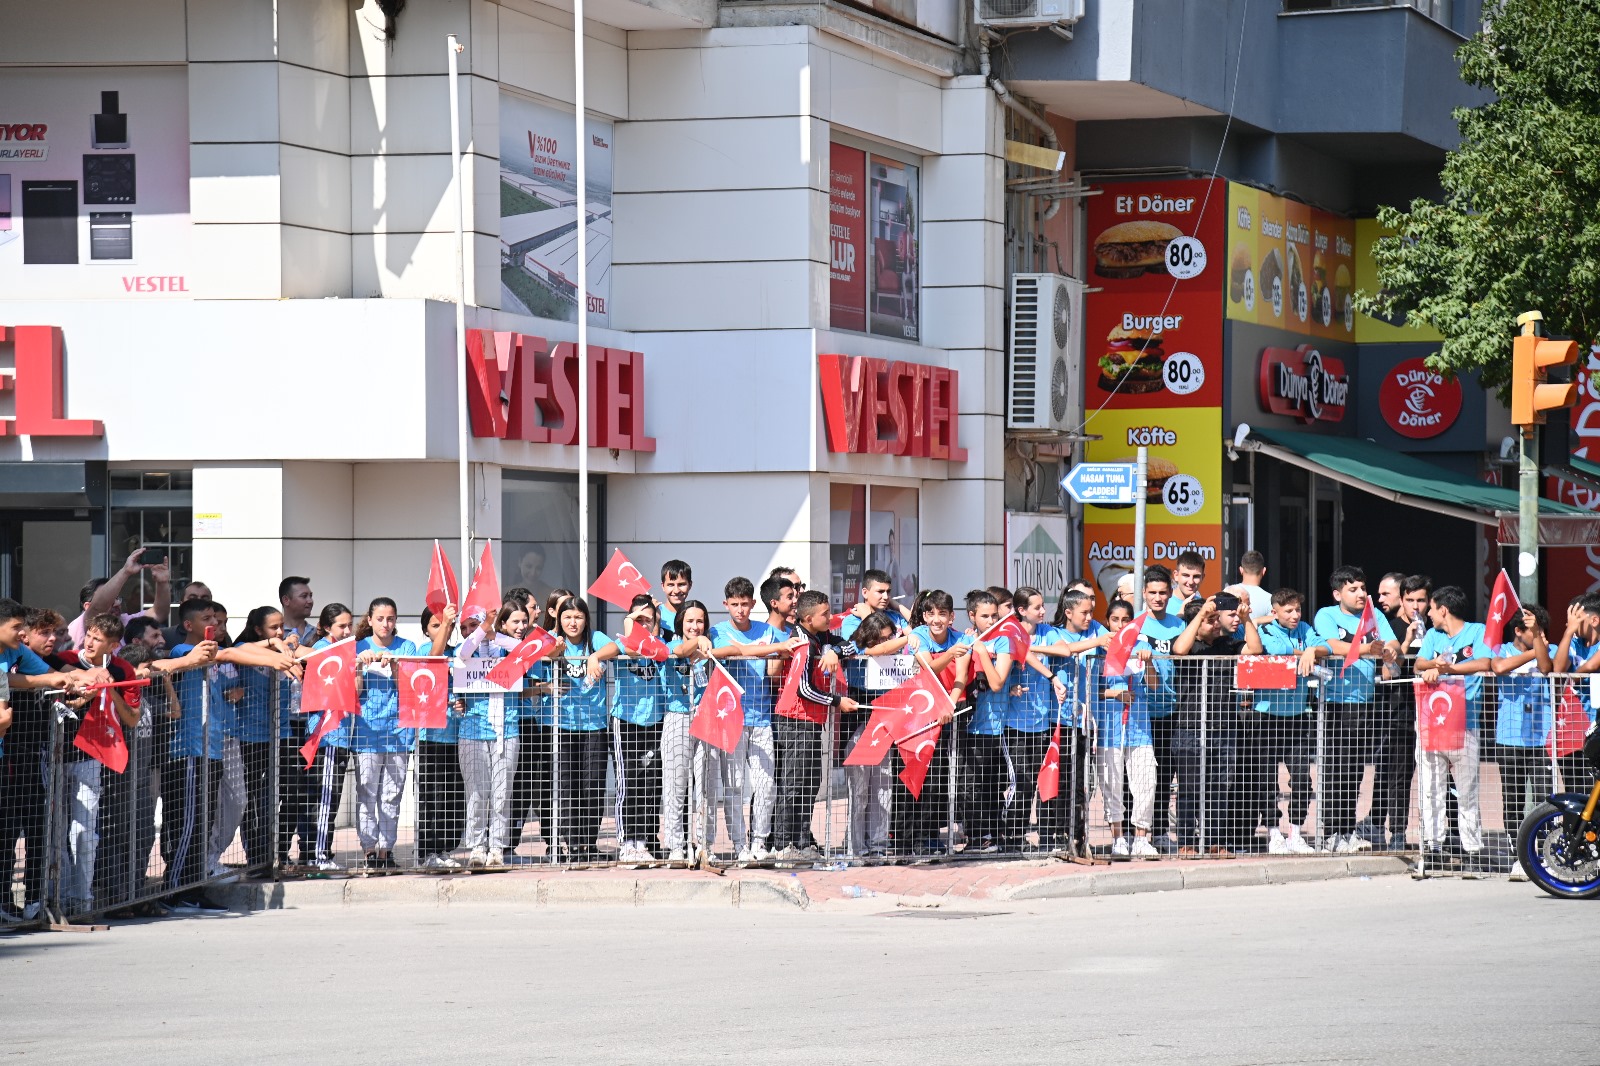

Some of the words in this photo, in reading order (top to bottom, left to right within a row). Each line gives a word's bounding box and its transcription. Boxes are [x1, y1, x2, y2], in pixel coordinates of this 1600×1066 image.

[1116, 196, 1133, 213] Et
[1138, 194, 1194, 213] Döner
[122, 276, 189, 292] VESTEL
[1123, 313, 1182, 334] Burger
[1280, 363, 1307, 409] Dünya
[1323, 370, 1348, 407] Döner
[1396, 369, 1443, 387] Dünya
[466, 328, 656, 452] VESTEL
[818, 353, 968, 462] VESTEL
[1398, 412, 1442, 427] Döner
[1128, 427, 1177, 446] Köfte
[1080, 474, 1105, 483] HASAN
[1106, 475, 1126, 483] TUNA
[1013, 558, 1064, 591] TOROS
